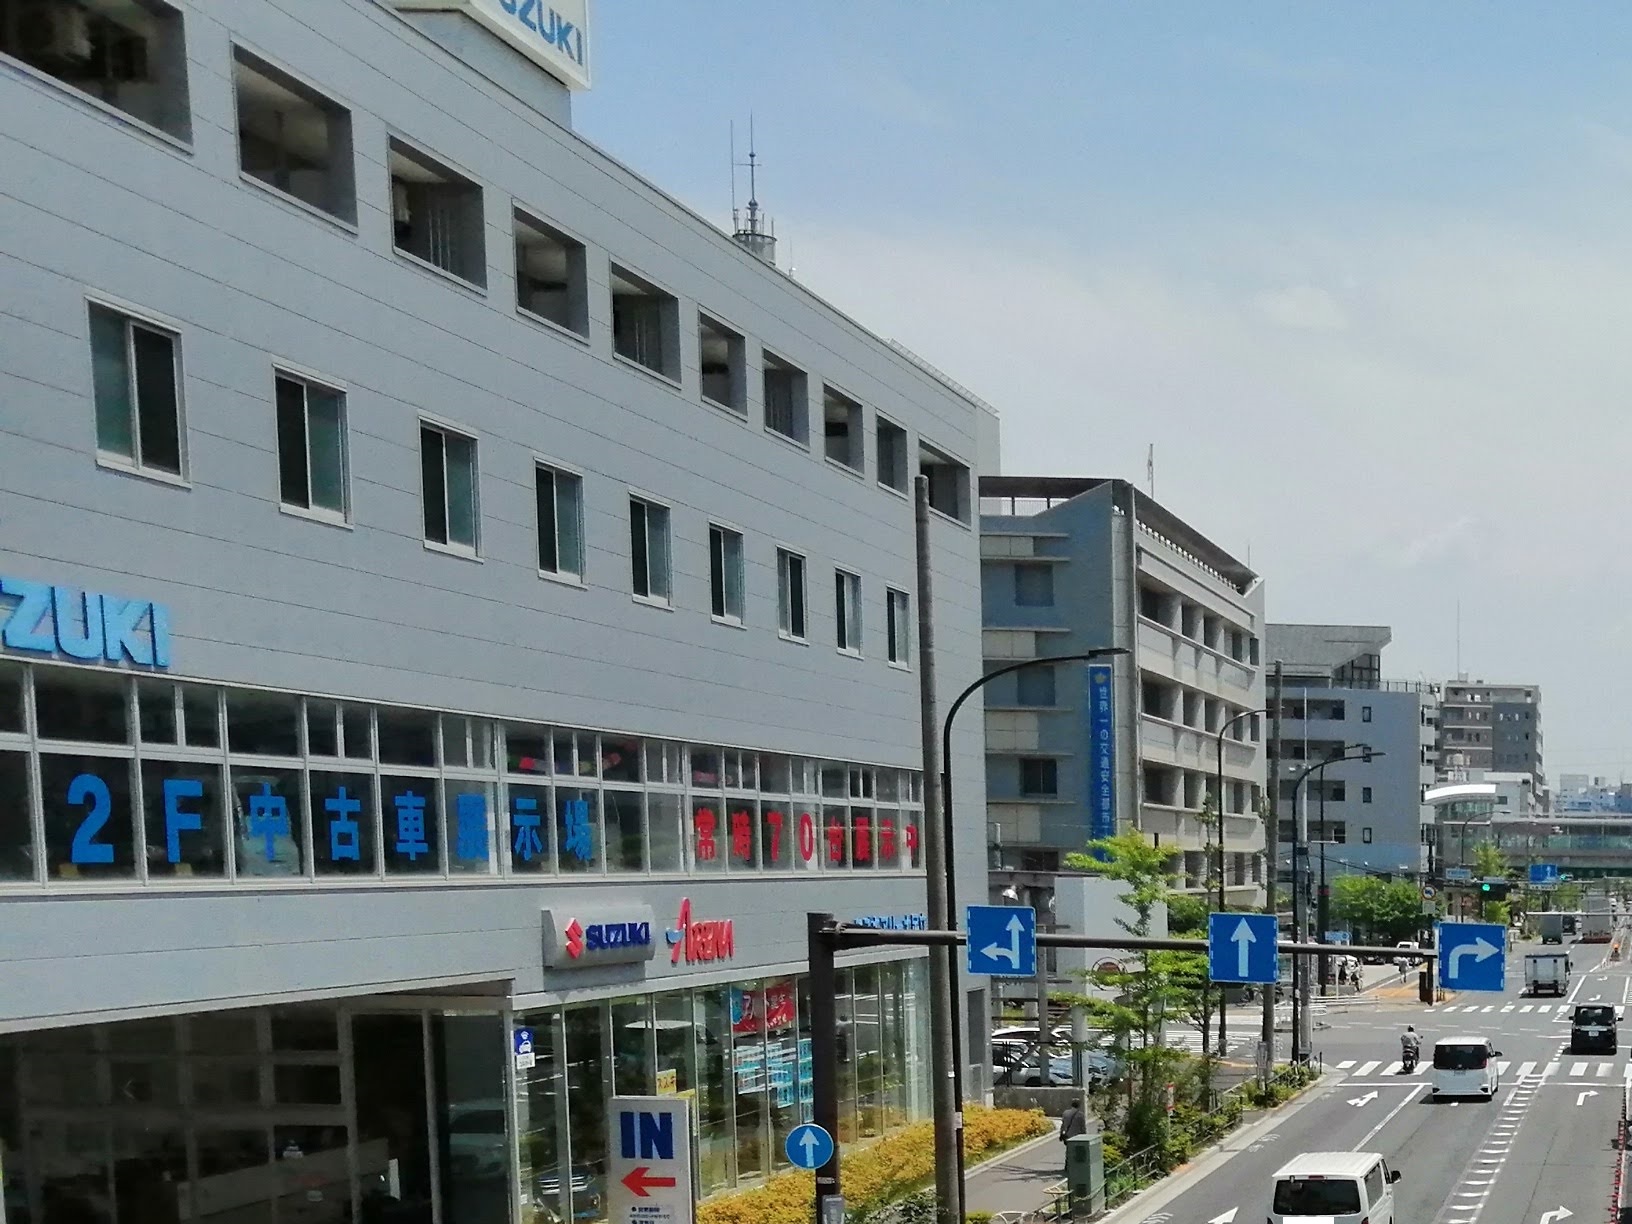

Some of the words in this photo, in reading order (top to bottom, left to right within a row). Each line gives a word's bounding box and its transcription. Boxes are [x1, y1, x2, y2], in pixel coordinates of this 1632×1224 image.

[500, 0, 584, 67] ZUKI
[586, 922, 650, 950] SUZUKI
[620, 1111, 674, 1160] IN
